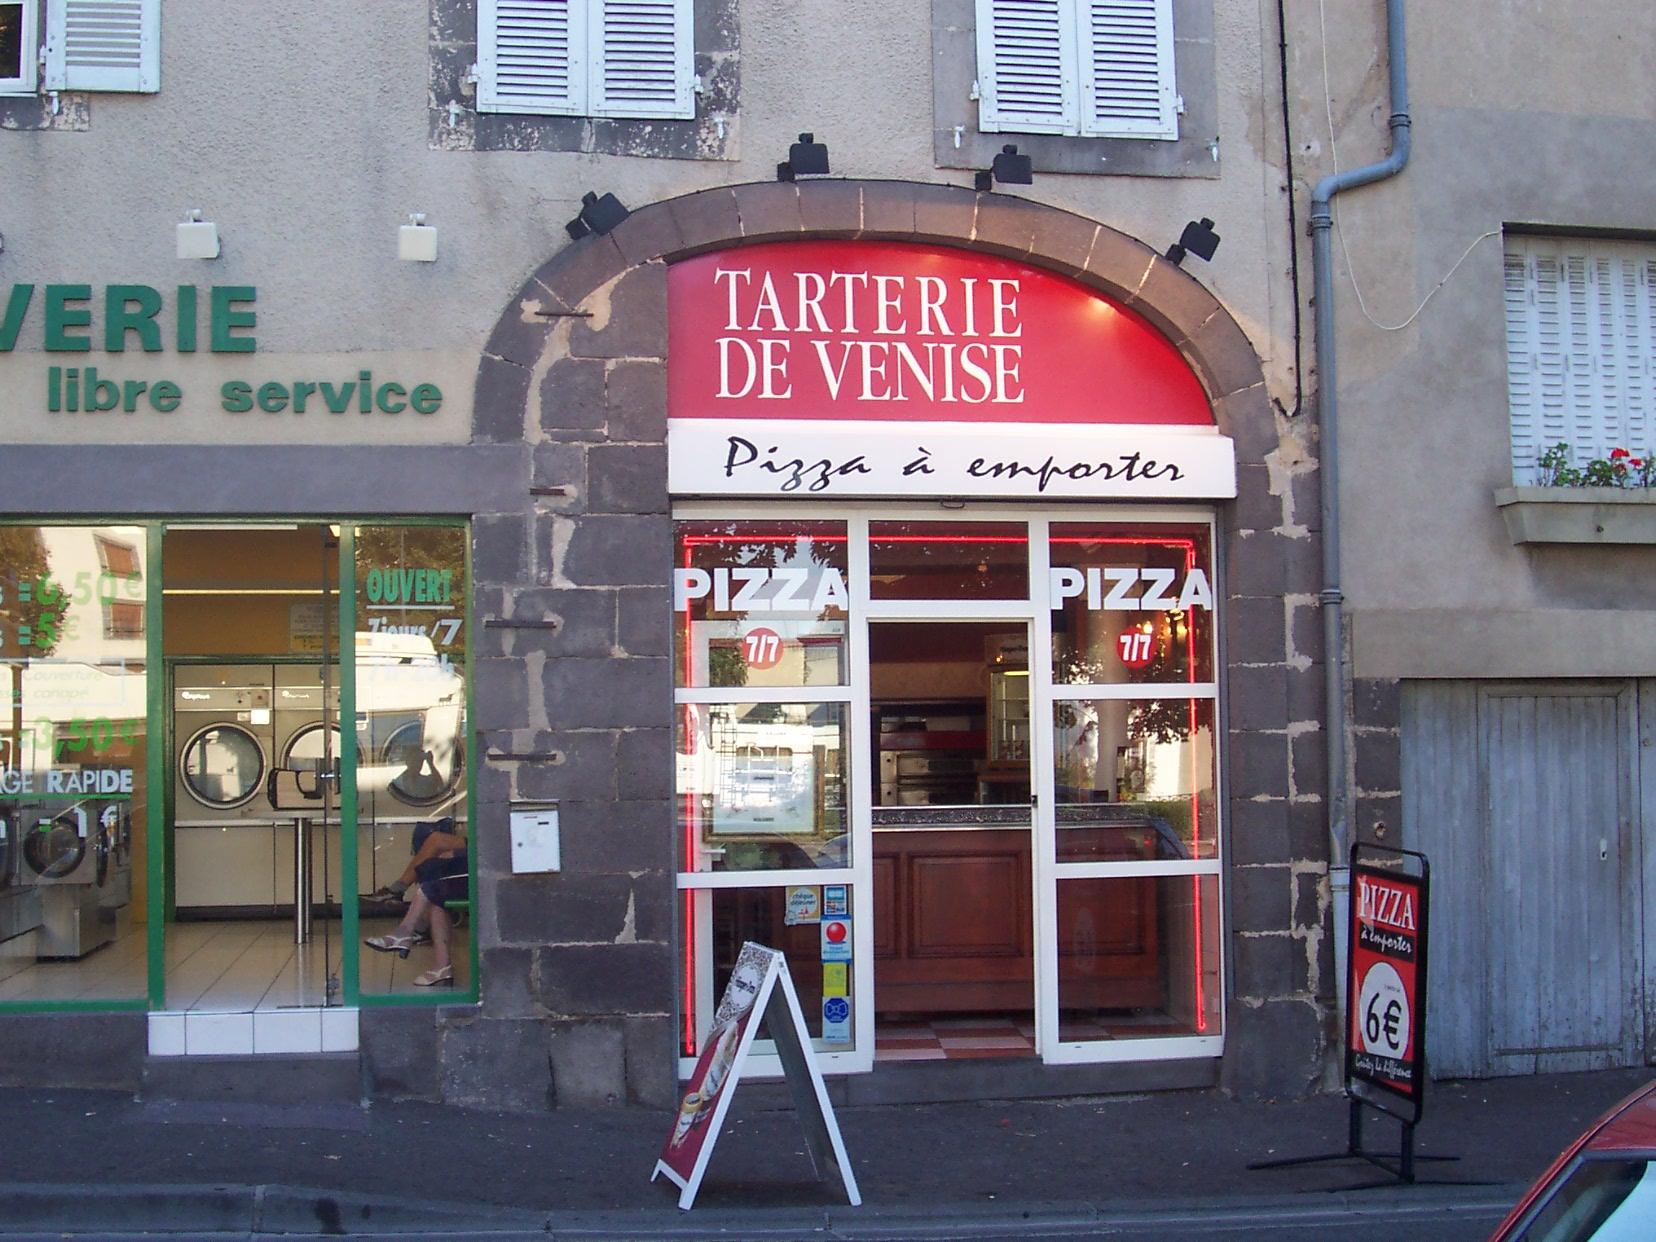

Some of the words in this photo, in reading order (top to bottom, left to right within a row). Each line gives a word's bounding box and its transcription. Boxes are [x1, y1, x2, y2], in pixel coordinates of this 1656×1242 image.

[713, 266, 1023, 337] TARTERIE
[47, 366, 183, 413] libre
[221, 370, 443, 414] service
[715, 337, 793, 400] DE
[810, 340, 1025, 404] VENISE
[725, 436, 871, 492] Pizza
[902, 447, 935, 474] à
[967, 451, 1185, 492] emporter
[366, 567, 453, 603] OUVERT
[674, 567, 849, 612] PIZZA
[1049, 568, 1212, 611] PIZZA
[745, 634, 779, 663] 7/7
[1119, 633, 1151, 661] 7/7
[46, 769, 133, 793] RAPIDE
[1359, 882, 1415, 930] PIZZA
